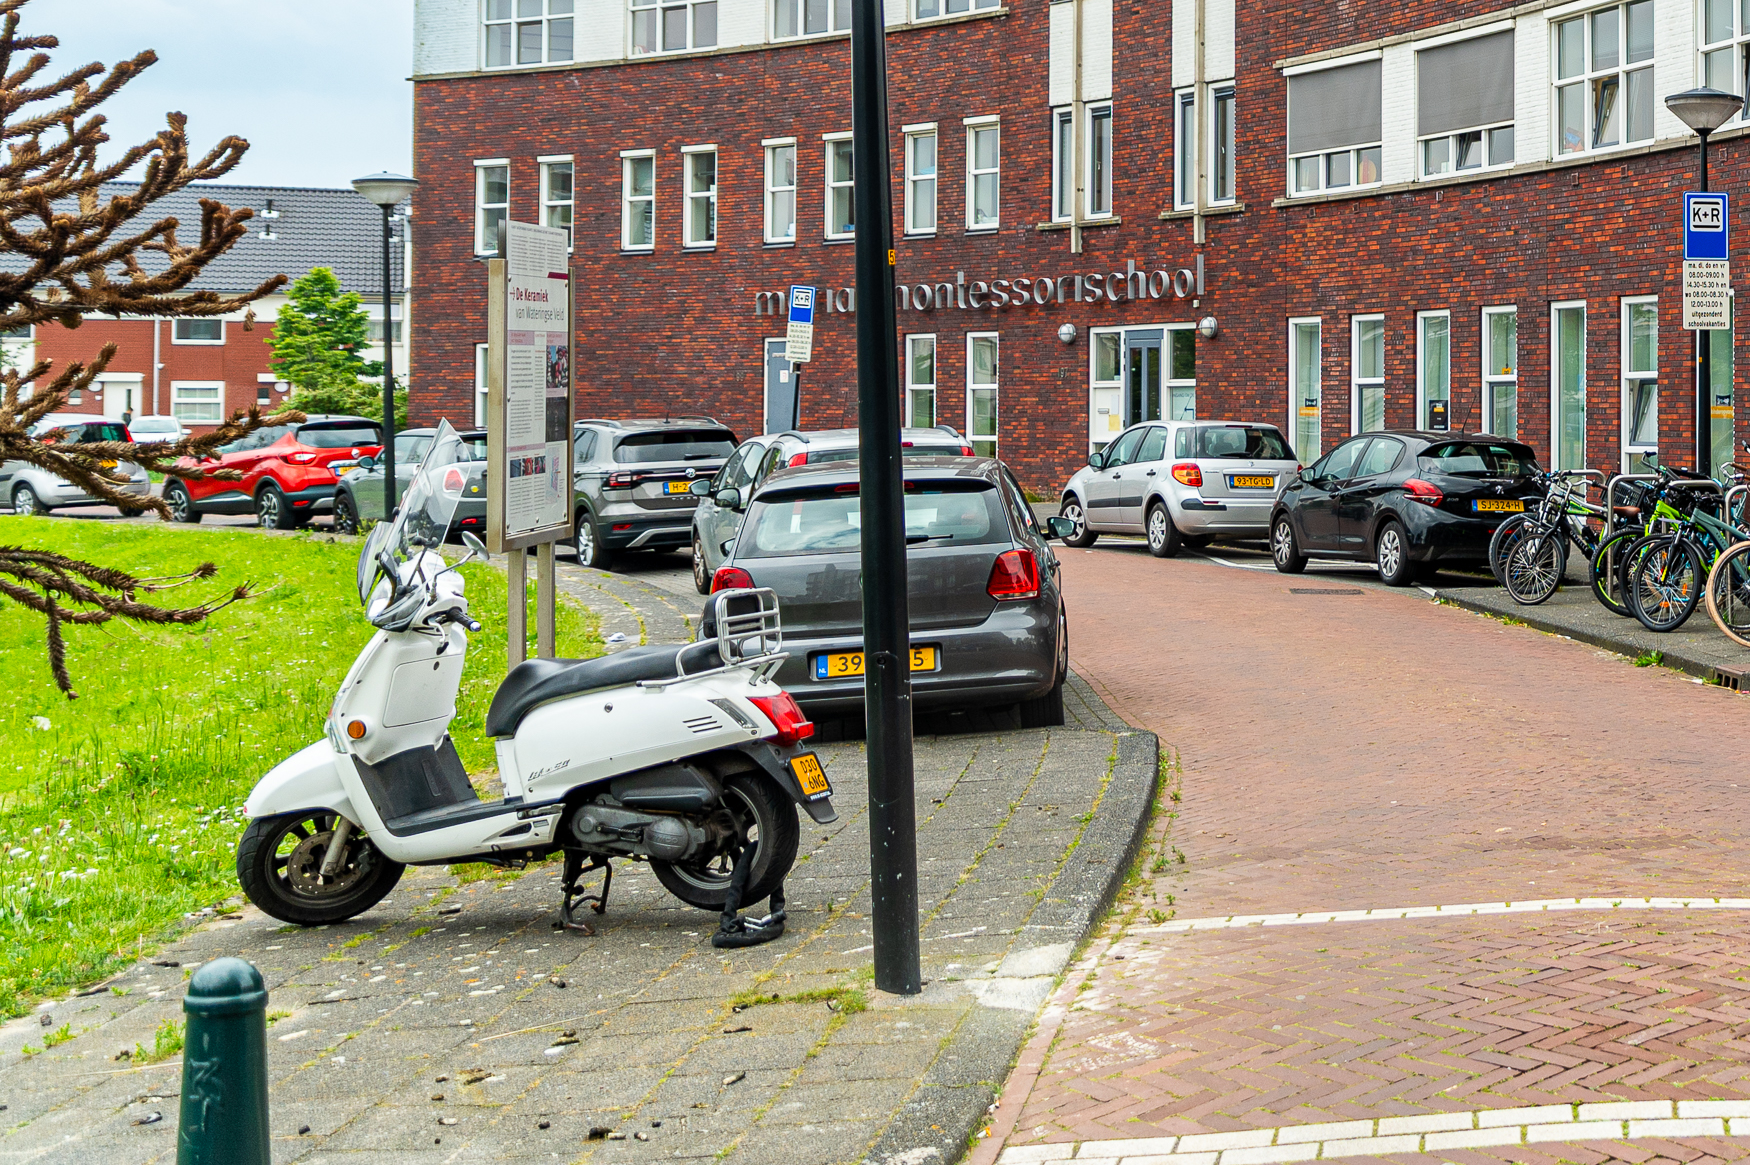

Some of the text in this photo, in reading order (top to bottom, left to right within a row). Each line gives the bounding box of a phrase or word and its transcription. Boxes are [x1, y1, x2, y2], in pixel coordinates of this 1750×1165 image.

[1692, 207, 1720, 223] K+R
[516, 287, 549, 303] De Keramiek
[756, 287, 854, 316] mia
[526, 305, 553, 324] Wateringse
[553, 307, 565, 321] Veld
[1691, 311, 1723, 319] uitgezonderd
[1481, 500, 1521, 510] SJ-324-H
